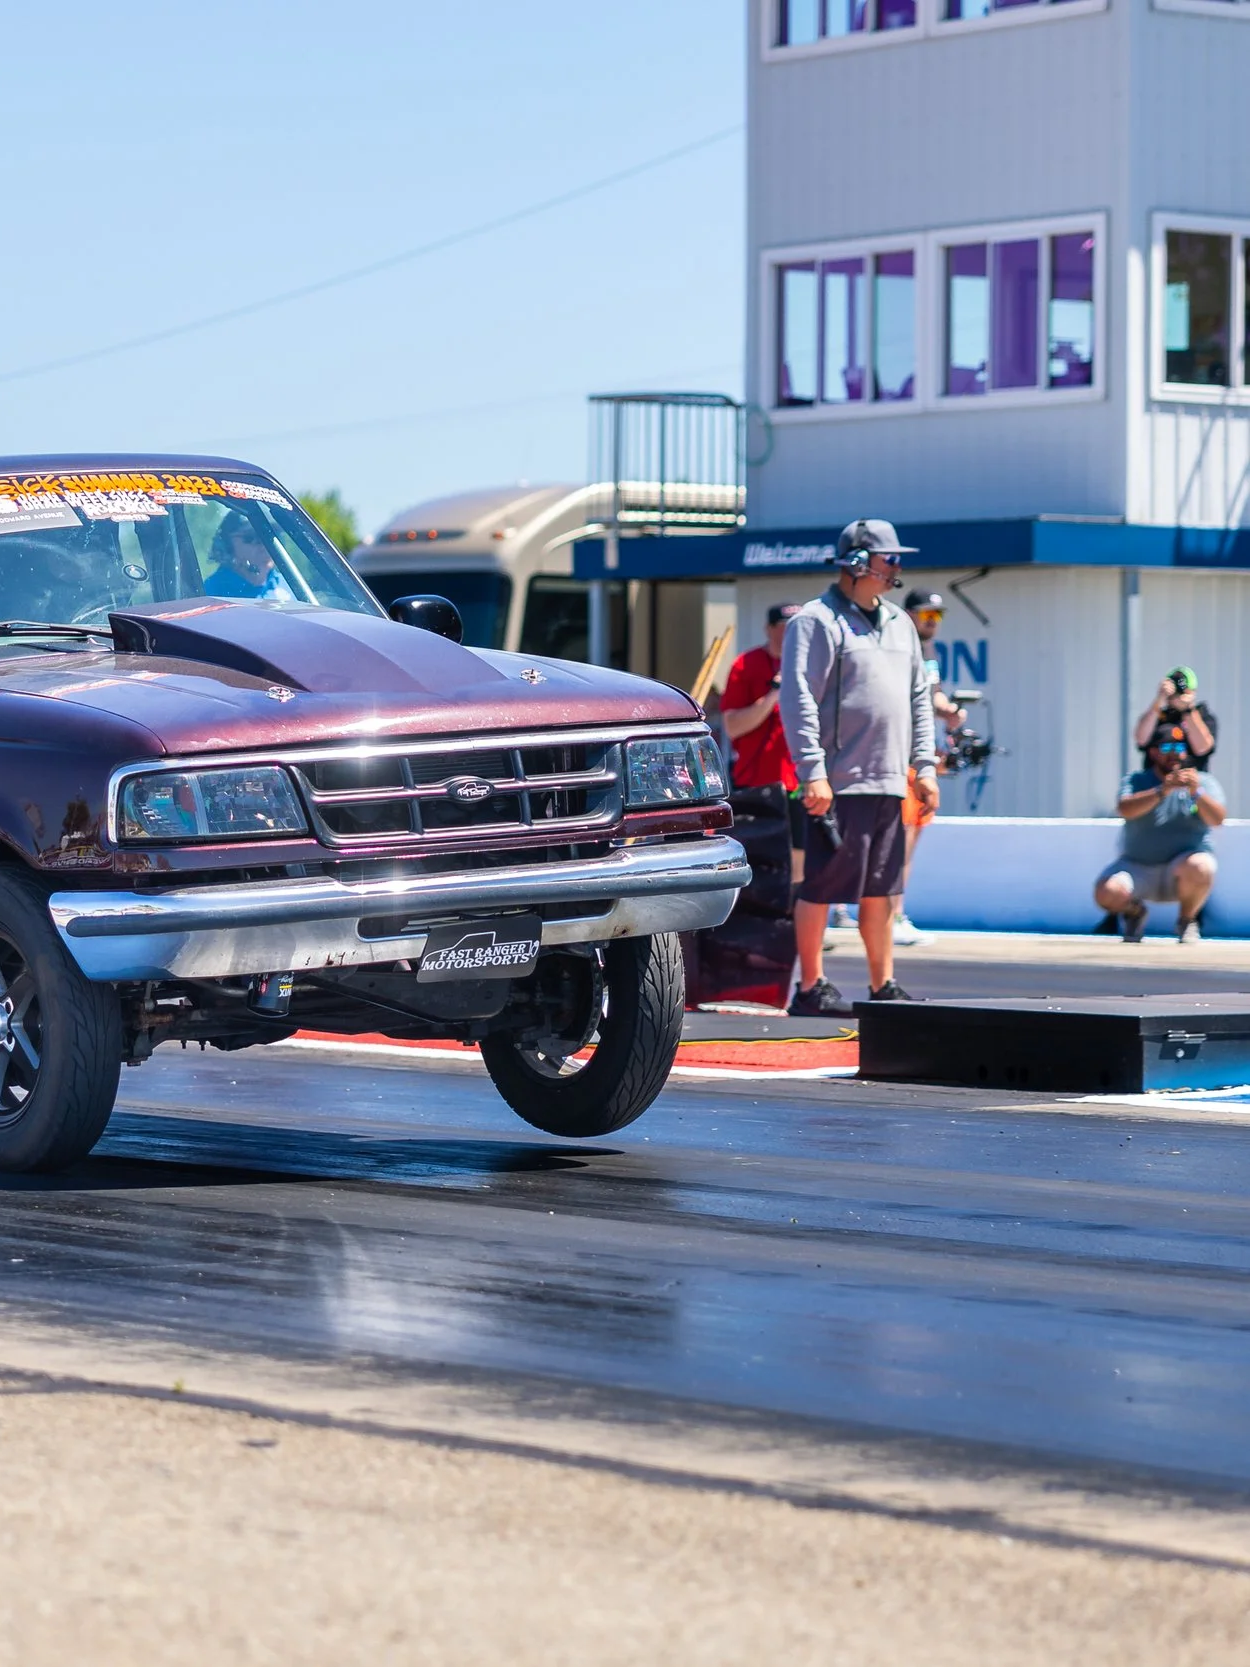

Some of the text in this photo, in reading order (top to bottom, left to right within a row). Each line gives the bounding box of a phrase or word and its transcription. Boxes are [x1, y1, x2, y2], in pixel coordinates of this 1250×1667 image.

[34, 511, 66, 521] AVENUE
[744, 542, 836, 567] Welcome
[439, 943, 527, 961] FAST RANGER
[421, 952, 530, 972] MOTORSPORTS
